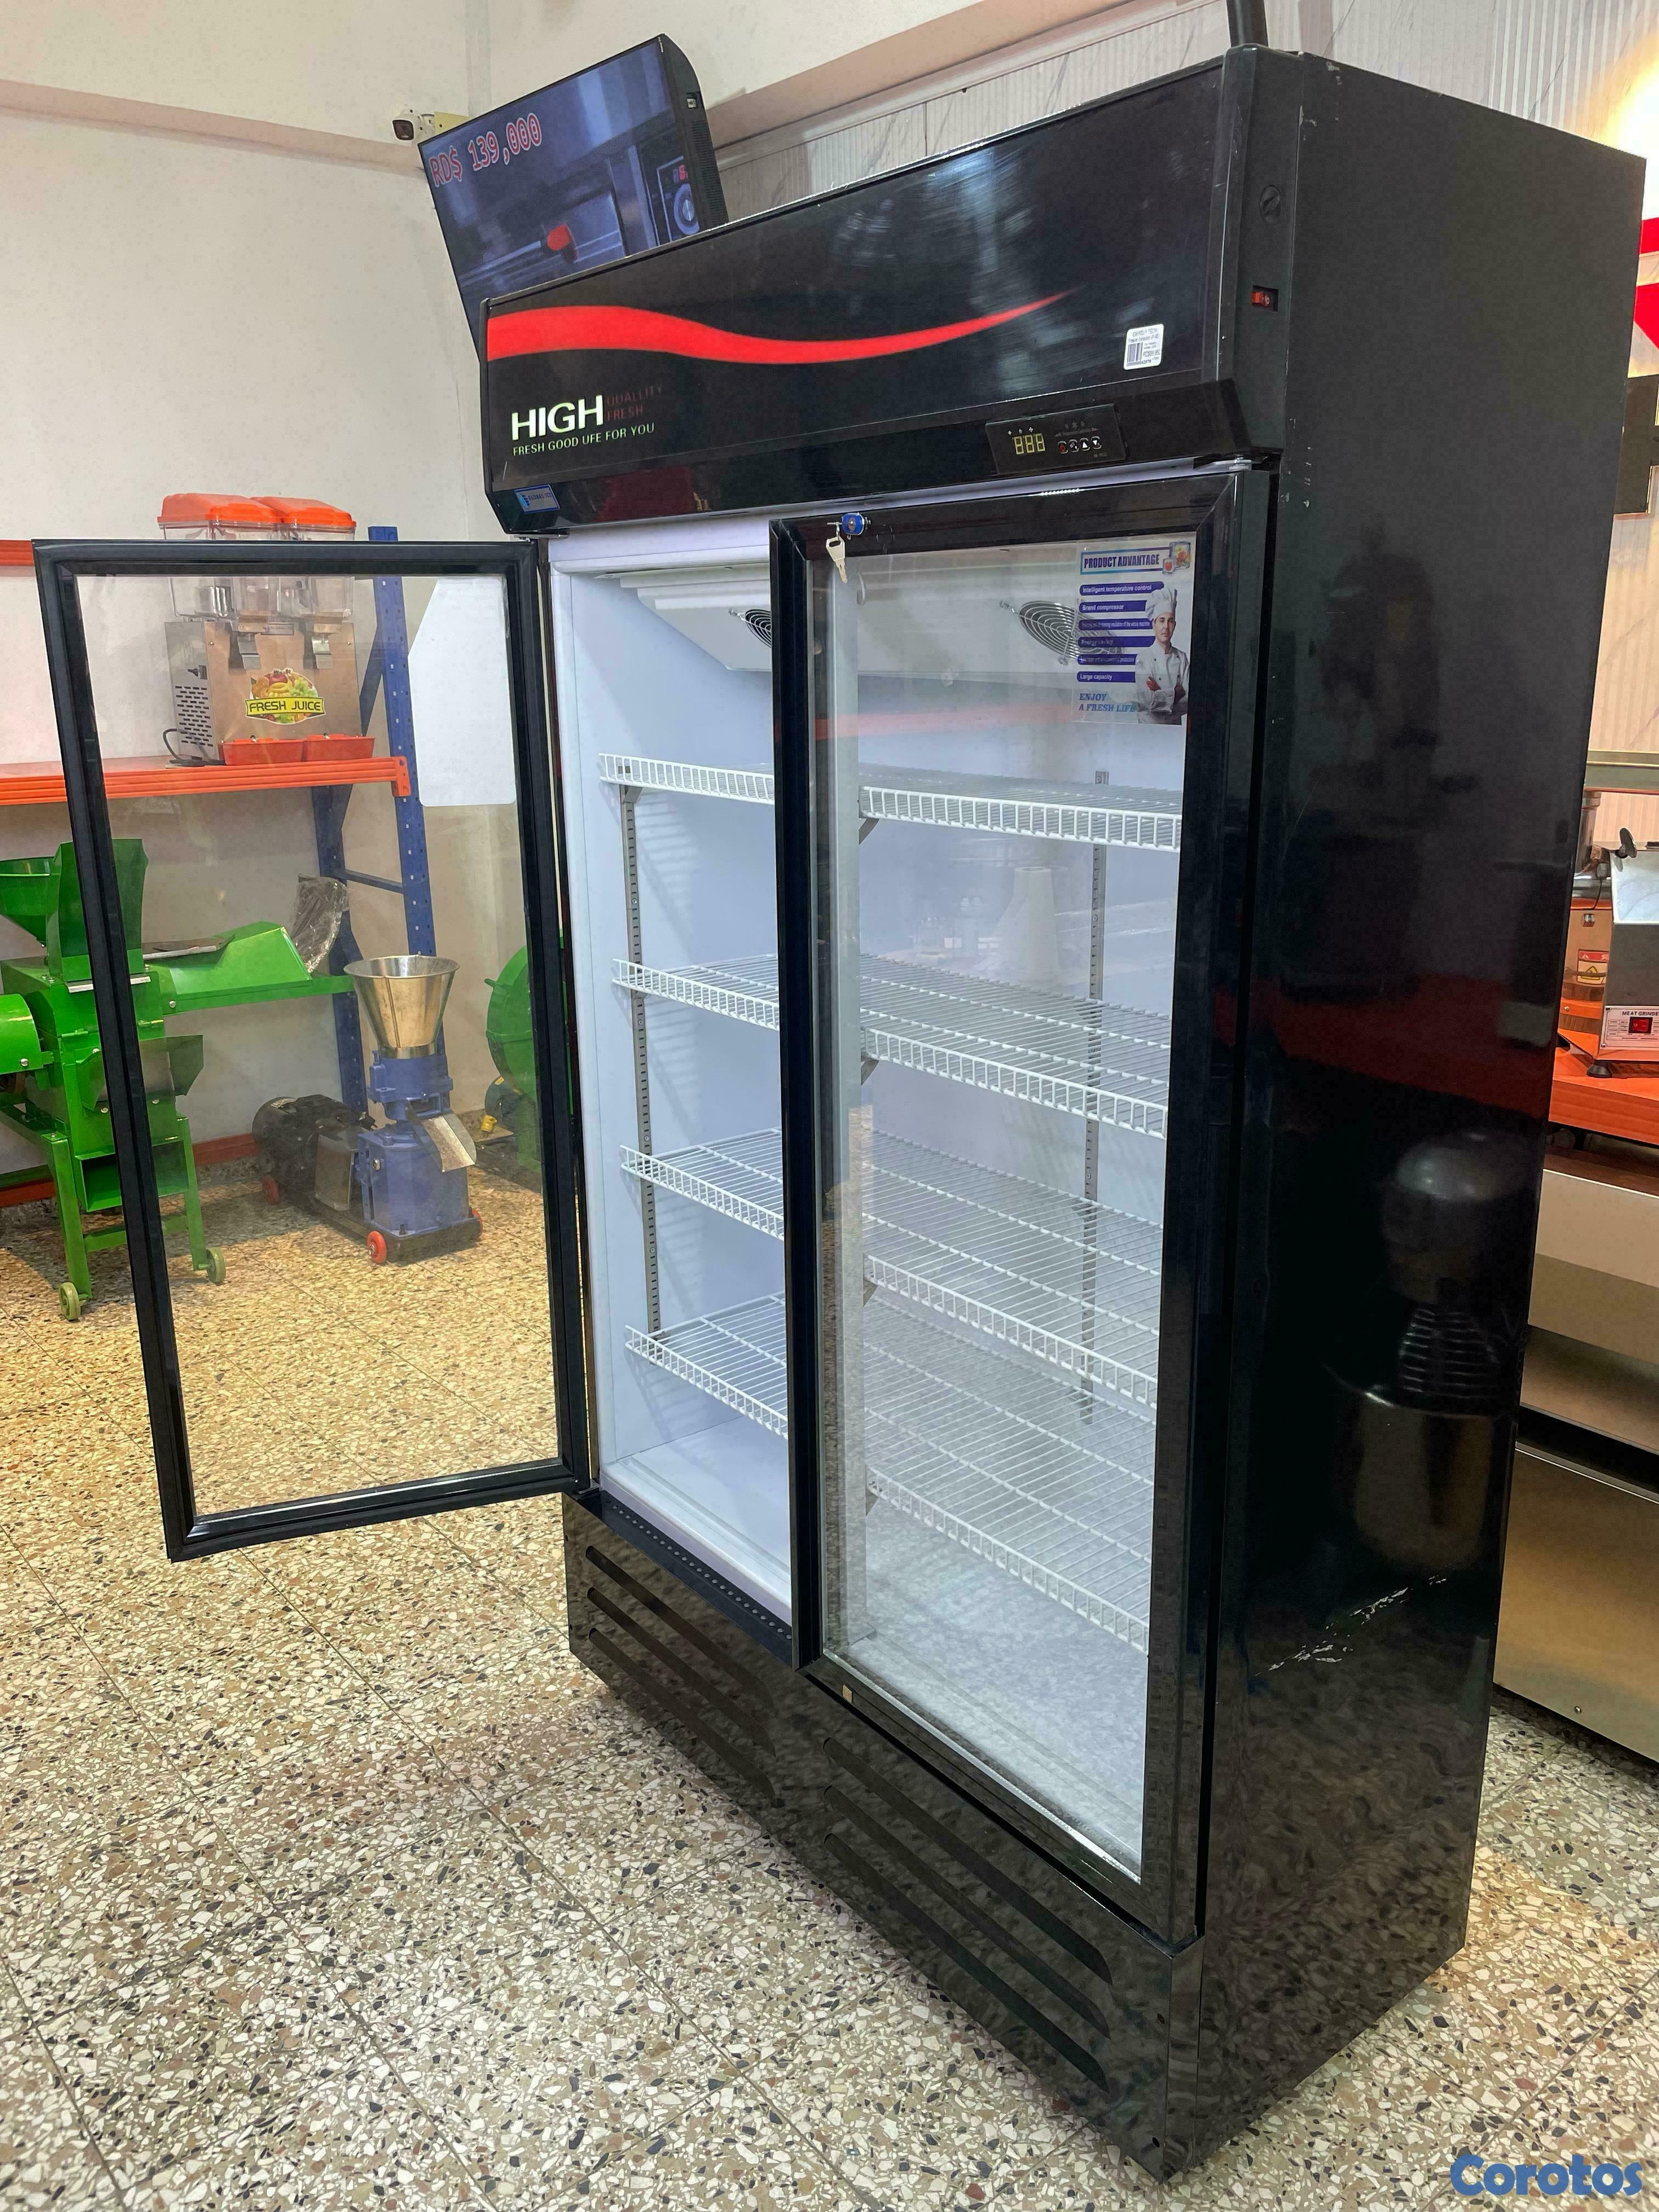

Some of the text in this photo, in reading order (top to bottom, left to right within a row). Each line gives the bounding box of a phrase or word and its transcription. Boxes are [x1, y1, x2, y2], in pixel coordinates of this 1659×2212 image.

[428, 112, 542, 188] RD$ 139,000
[511, 394, 604, 441] HIGH
[513, 442, 544, 456] FRESH
[548, 437, 578, 451] GOOD
[605, 428, 627, 441] FOR
[630, 423, 654, 436] YOU
[1084, 554, 1159, 569] PRODUCT ADVANTAGE
[249, 700, 321, 713] FRESH JUICE
[1079, 693, 1107, 702] ENJOY
